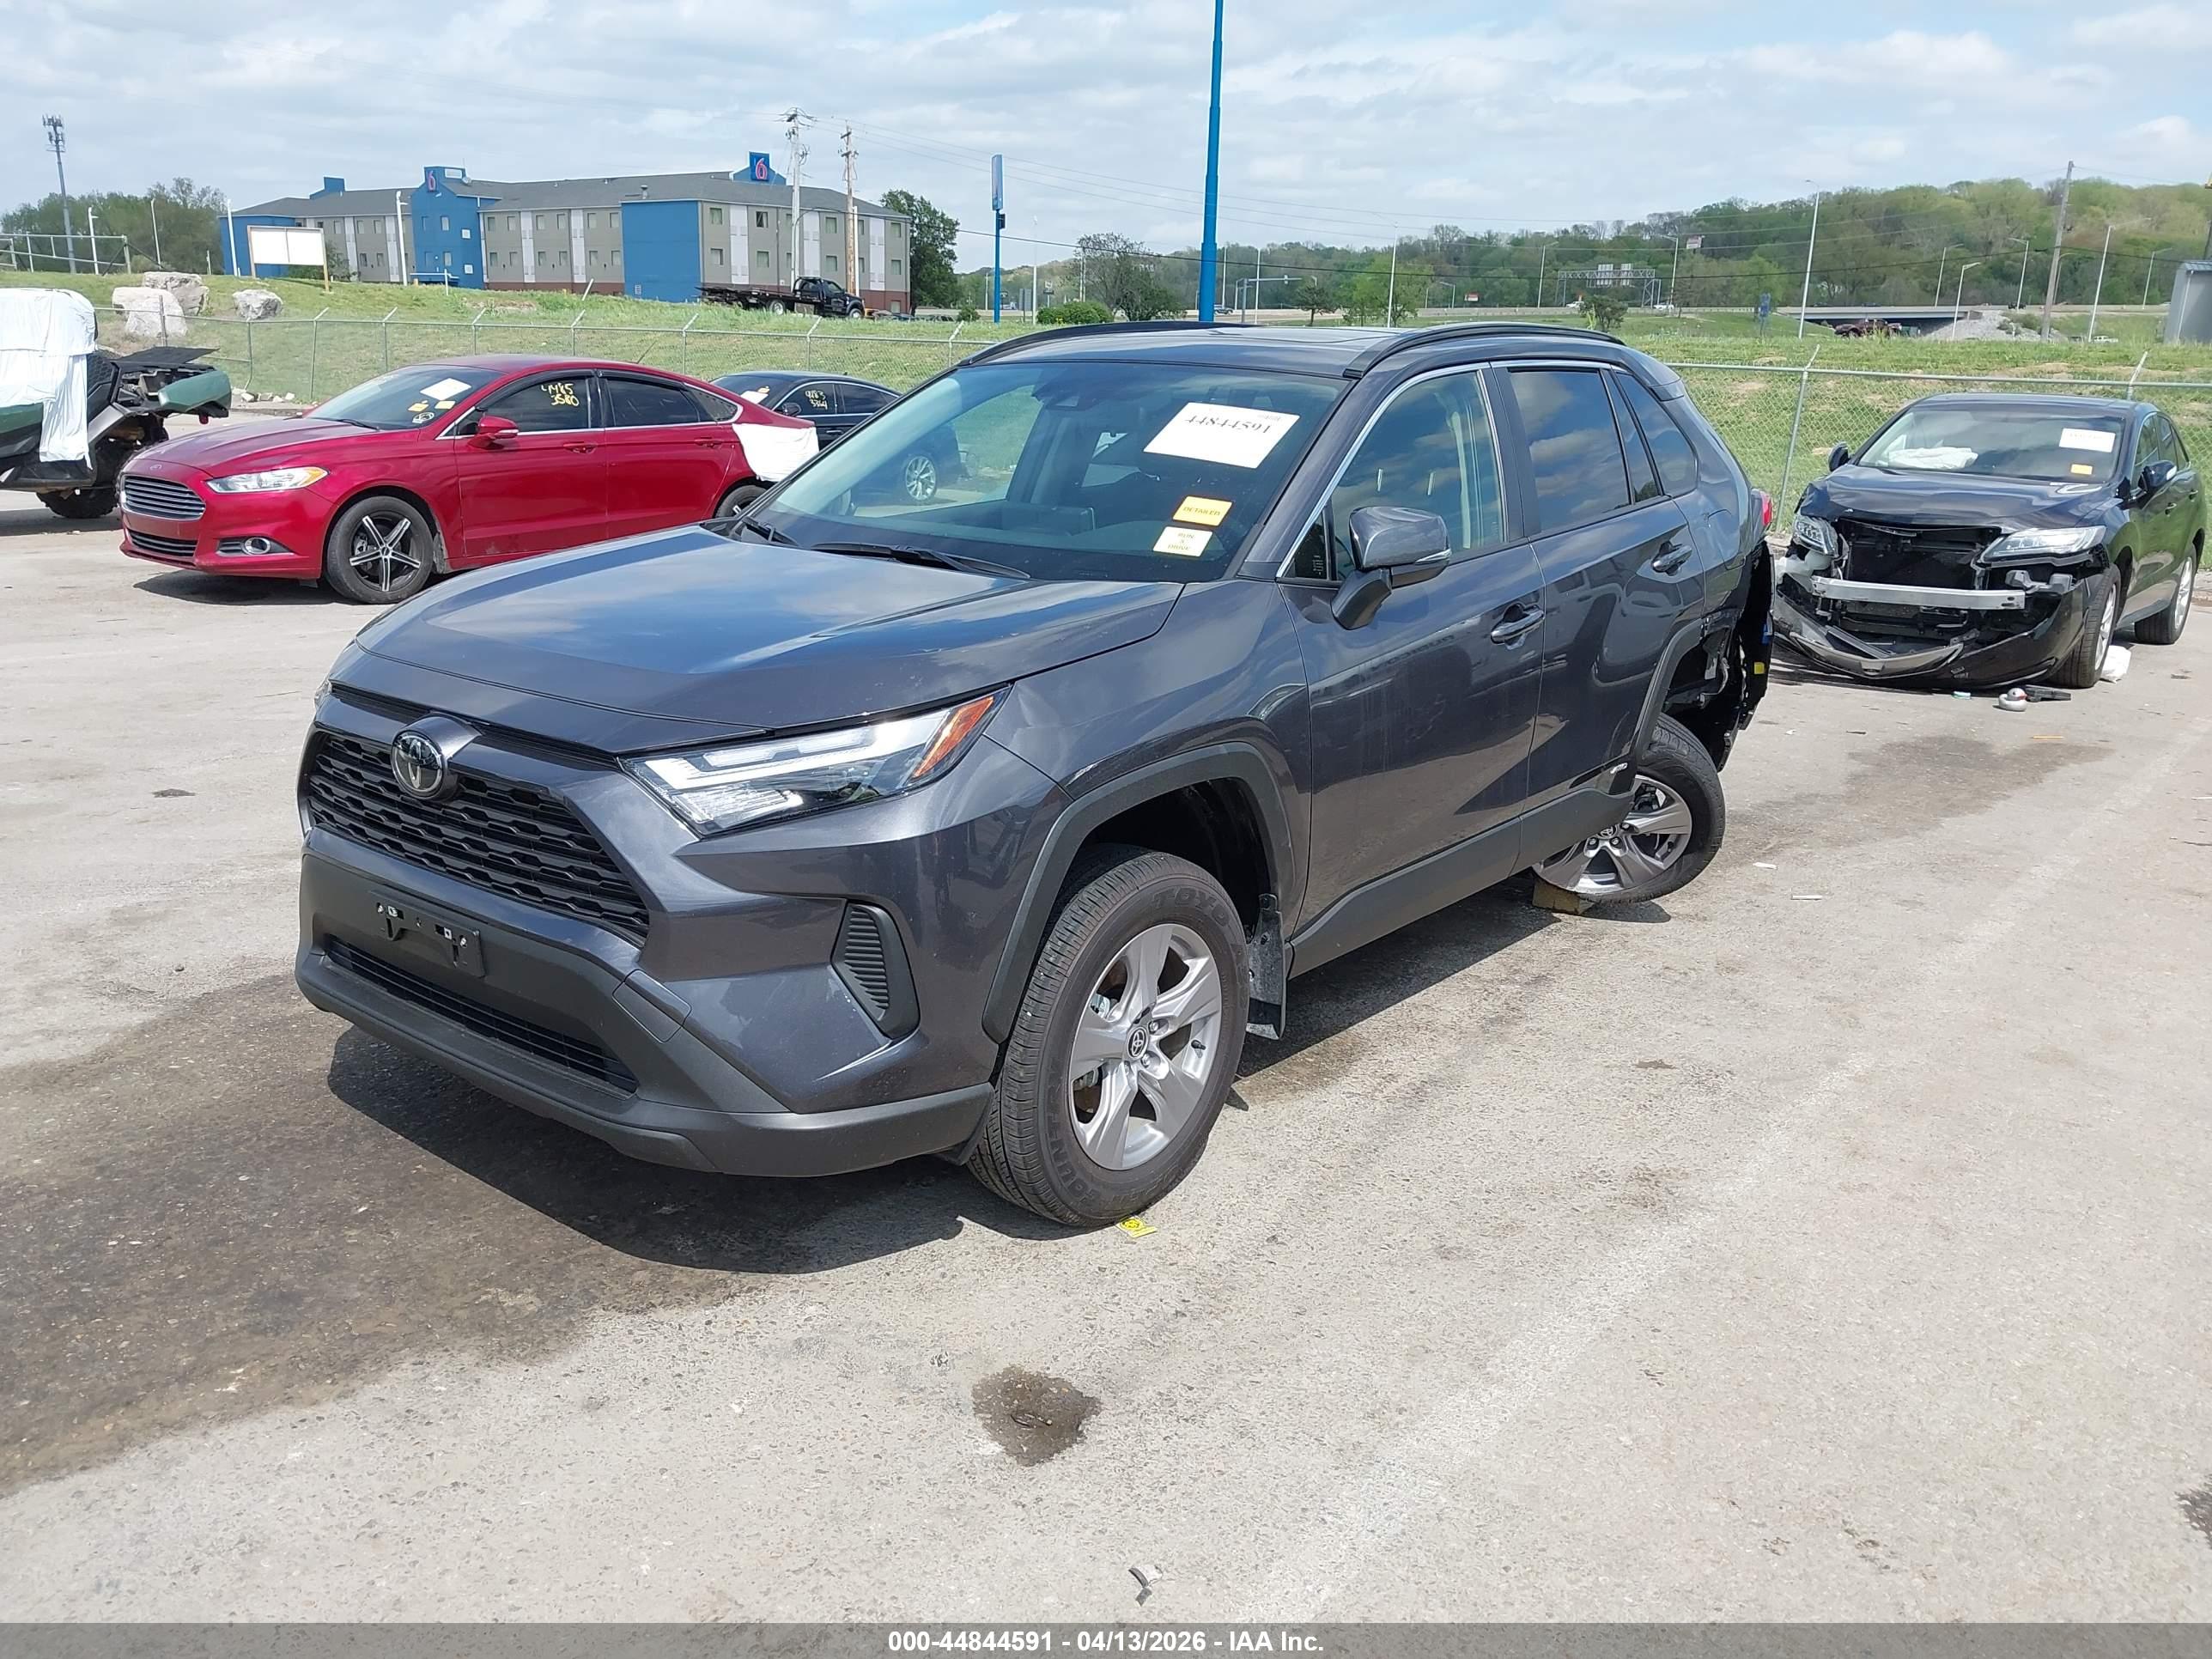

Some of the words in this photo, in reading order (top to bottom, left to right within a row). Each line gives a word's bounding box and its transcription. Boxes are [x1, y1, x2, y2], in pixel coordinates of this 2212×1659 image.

[756, 157, 768, 179] 6
[428, 170, 436, 191] 6
[1184, 415, 1271, 434] 44844591
[1182, 506, 1221, 516] DETAILED
[1152, 885, 1230, 927] TOYO
